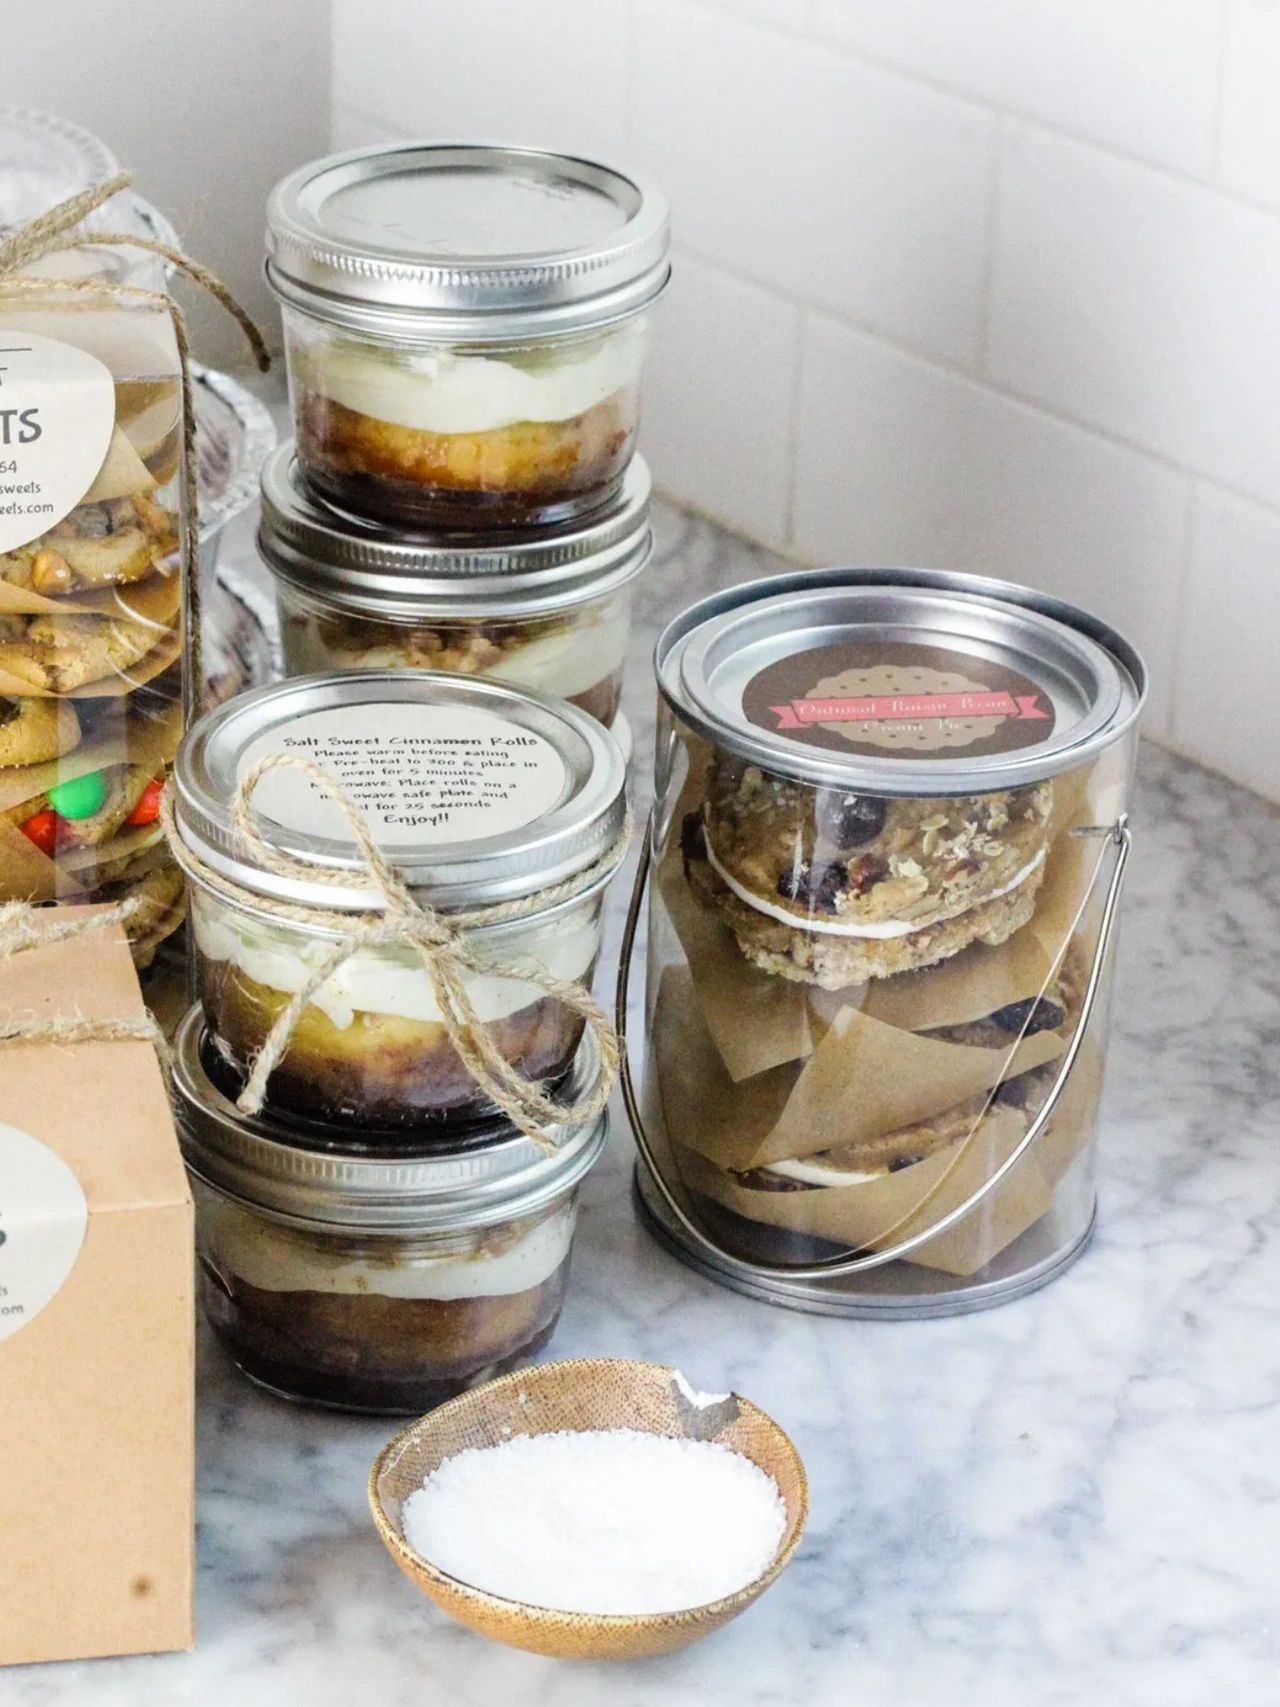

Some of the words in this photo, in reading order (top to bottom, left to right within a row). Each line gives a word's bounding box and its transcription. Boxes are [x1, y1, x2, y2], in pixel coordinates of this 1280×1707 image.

[282, 737, 319, 747] Salt
[328, 736, 380, 746] Sweet
[389, 736, 482, 745] Cinnamon
[489, 736, 538, 746] Rolls
[314, 749, 361, 758] Please
[410, 747, 458, 757] before
[464, 749, 509, 760] eating
[481, 759, 517, 769] place
[341, 769, 375, 778] oven
[382, 767, 403, 776] for
[426, 767, 484, 778] minutes
[397, 778, 436, 788] Place
[443, 778, 477, 787] rolls
[484, 780, 502, 788] on
[403, 789, 432, 799] safe
[438, 789, 474, 799] plate
[481, 791, 509, 800] and
[376, 801, 398, 811] for
[430, 799, 492, 809] seconds
[383, 812, 449, 827] Enjoy!!
